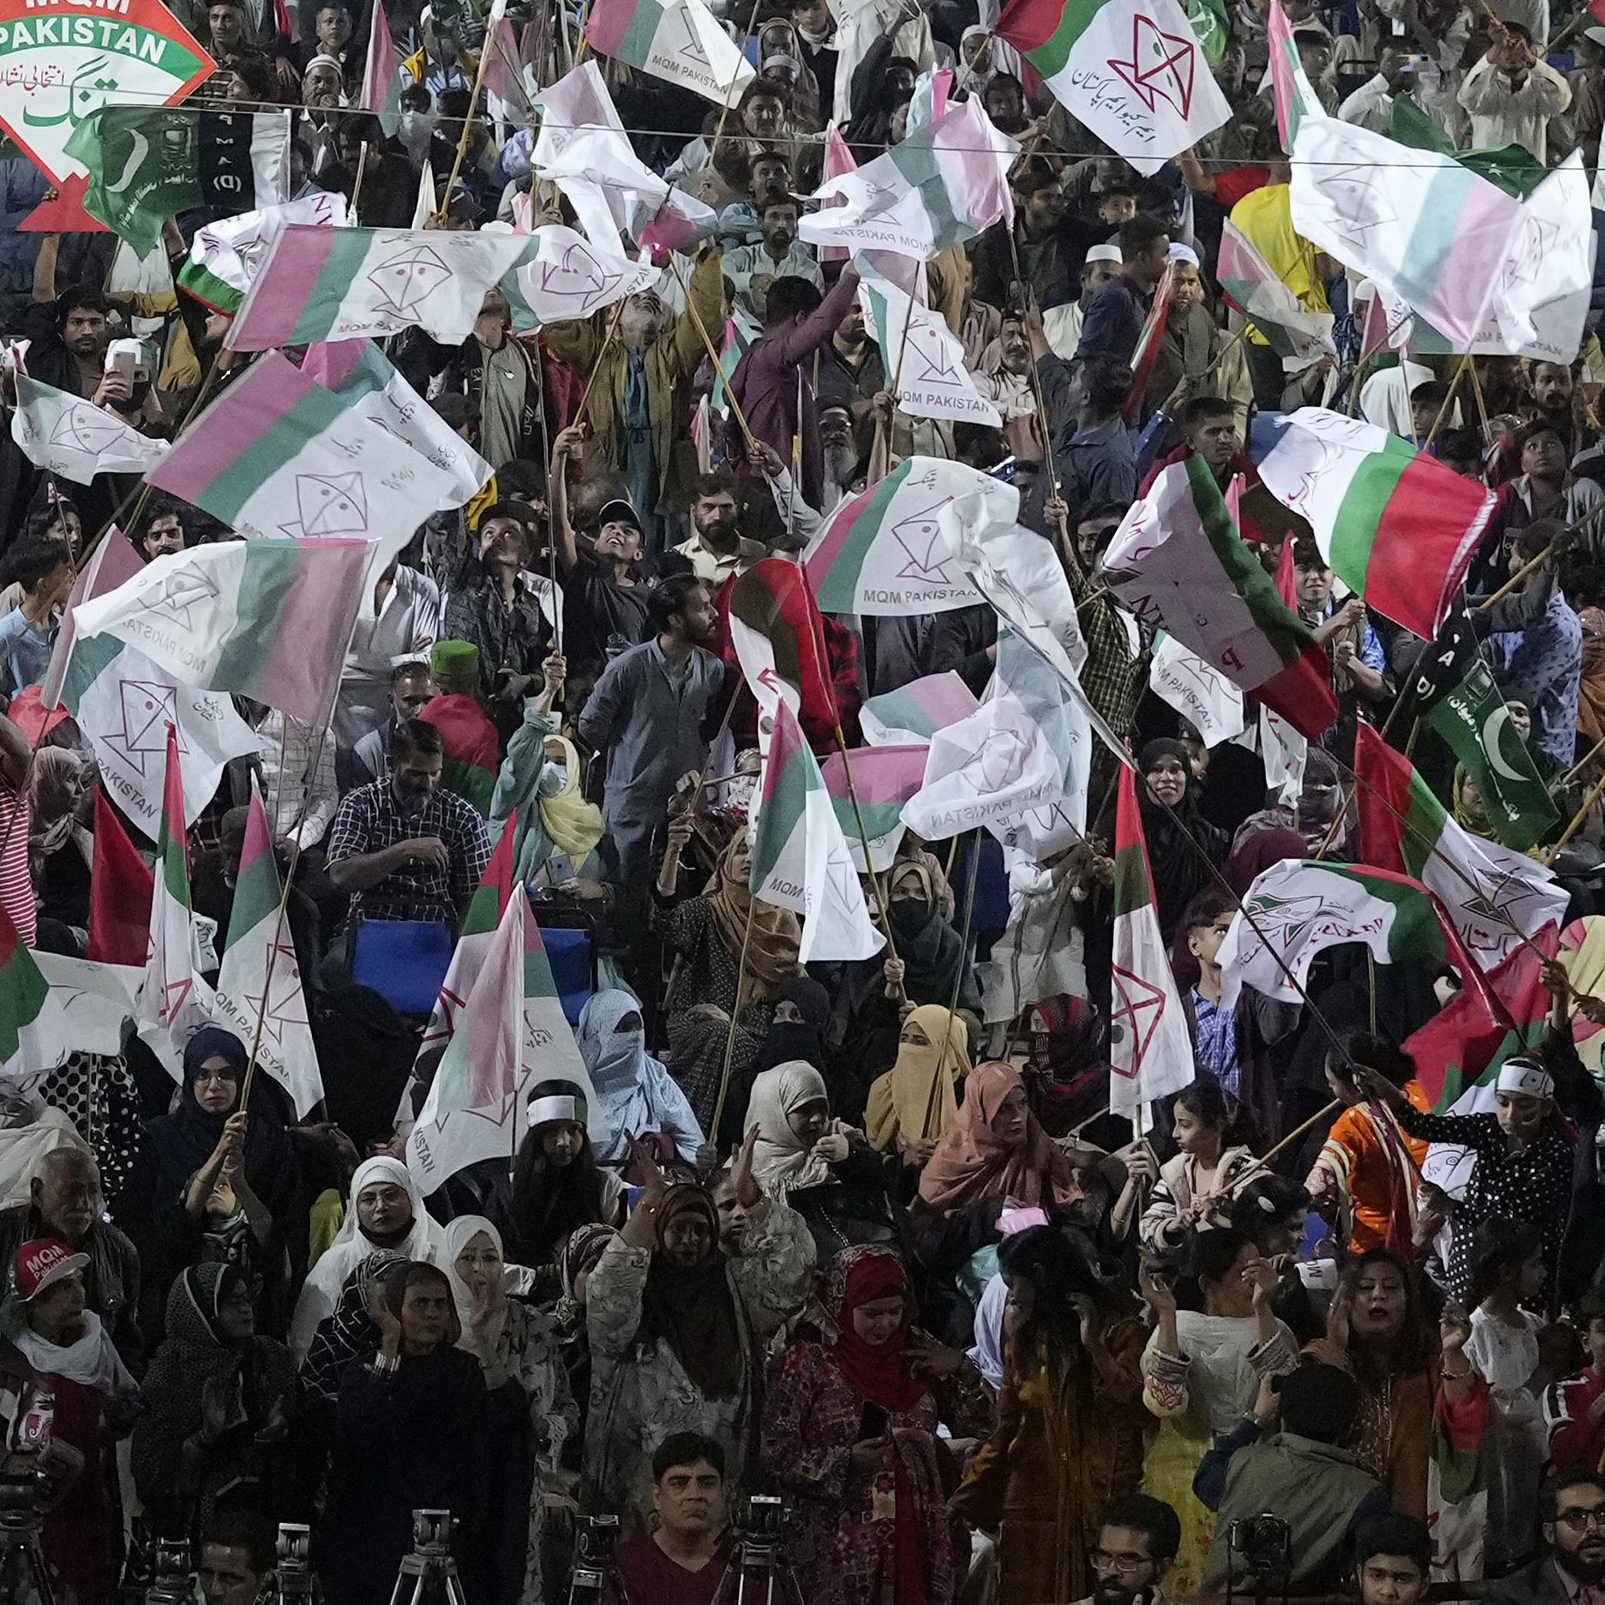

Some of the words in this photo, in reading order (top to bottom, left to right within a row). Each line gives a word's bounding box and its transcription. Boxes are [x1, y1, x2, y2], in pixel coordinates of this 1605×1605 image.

[651, 55, 679, 76] MQM
[680, 65, 729, 95] PAKISTAN
[899, 391, 925, 402] QM
[926, 393, 990, 414] PAKISTAN
[863, 589, 902, 604] MQM
[904, 588, 977, 603] PAKISTAN
[1169, 676, 1213, 731] PAKISTAN
[770, 879, 804, 899] MQM
[413, 1127, 436, 1174] KISTAN
[25, 1244, 66, 1273] MQM
